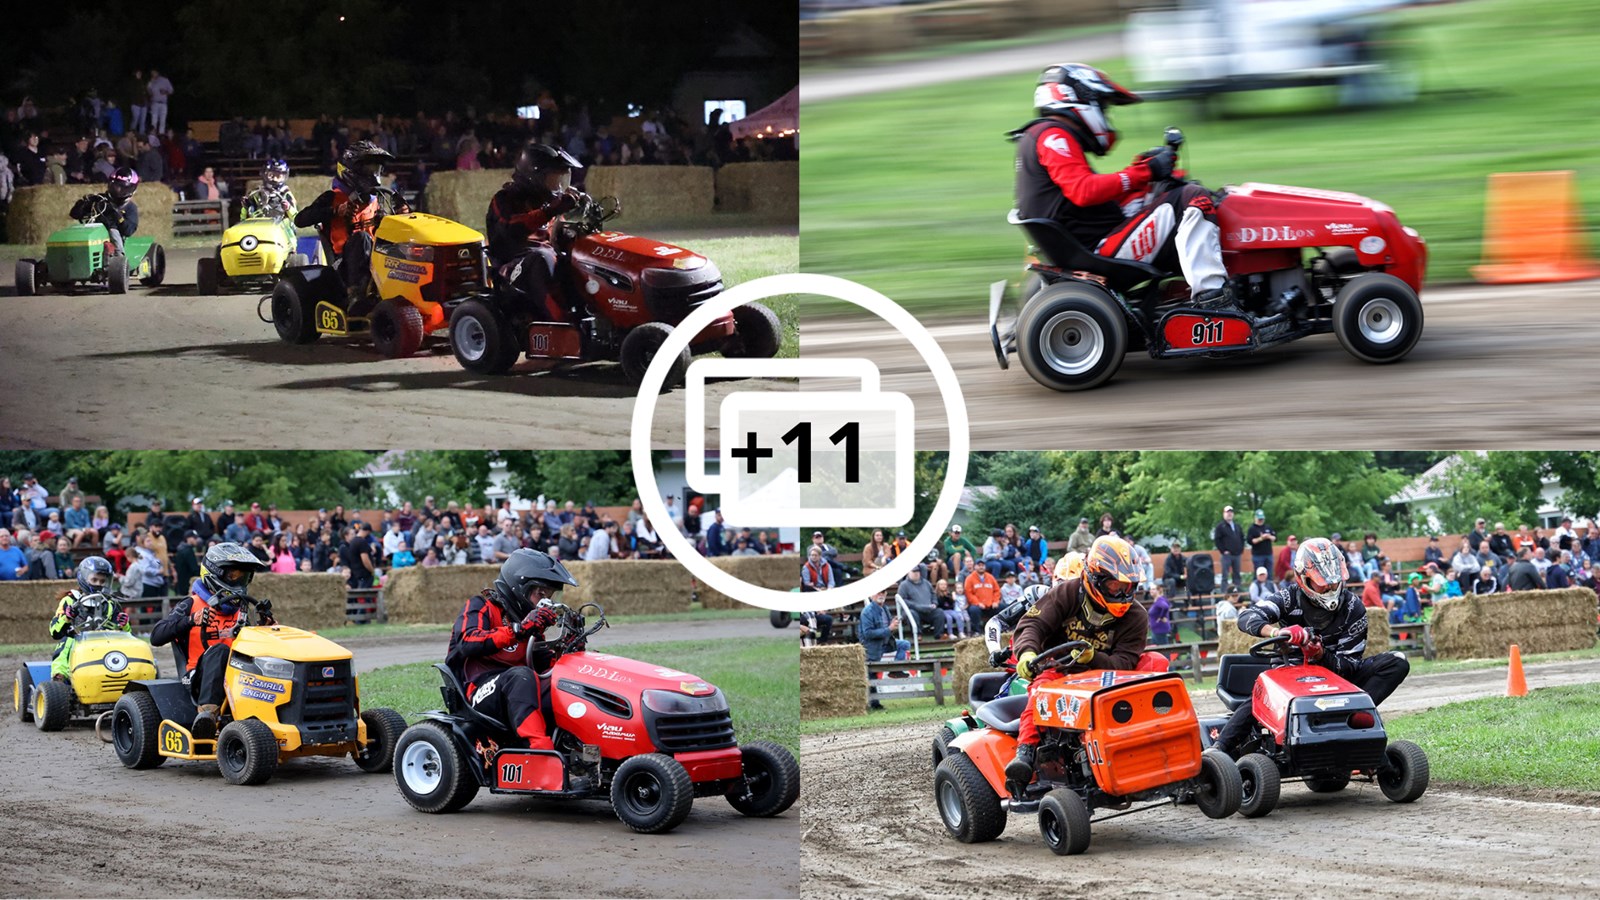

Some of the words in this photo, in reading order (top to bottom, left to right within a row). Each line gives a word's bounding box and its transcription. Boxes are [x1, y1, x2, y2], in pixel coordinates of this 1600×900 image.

[322, 310, 338, 329] 65
[532, 333, 549, 351] 101
[1191, 320, 1224, 345] 911
[241, 687, 275, 702] ENGINE
[253, 679, 285, 693] SMALL
[165, 730, 183, 752] 65
[1086, 739, 1104, 765] 01
[502, 763, 523, 783] 101
